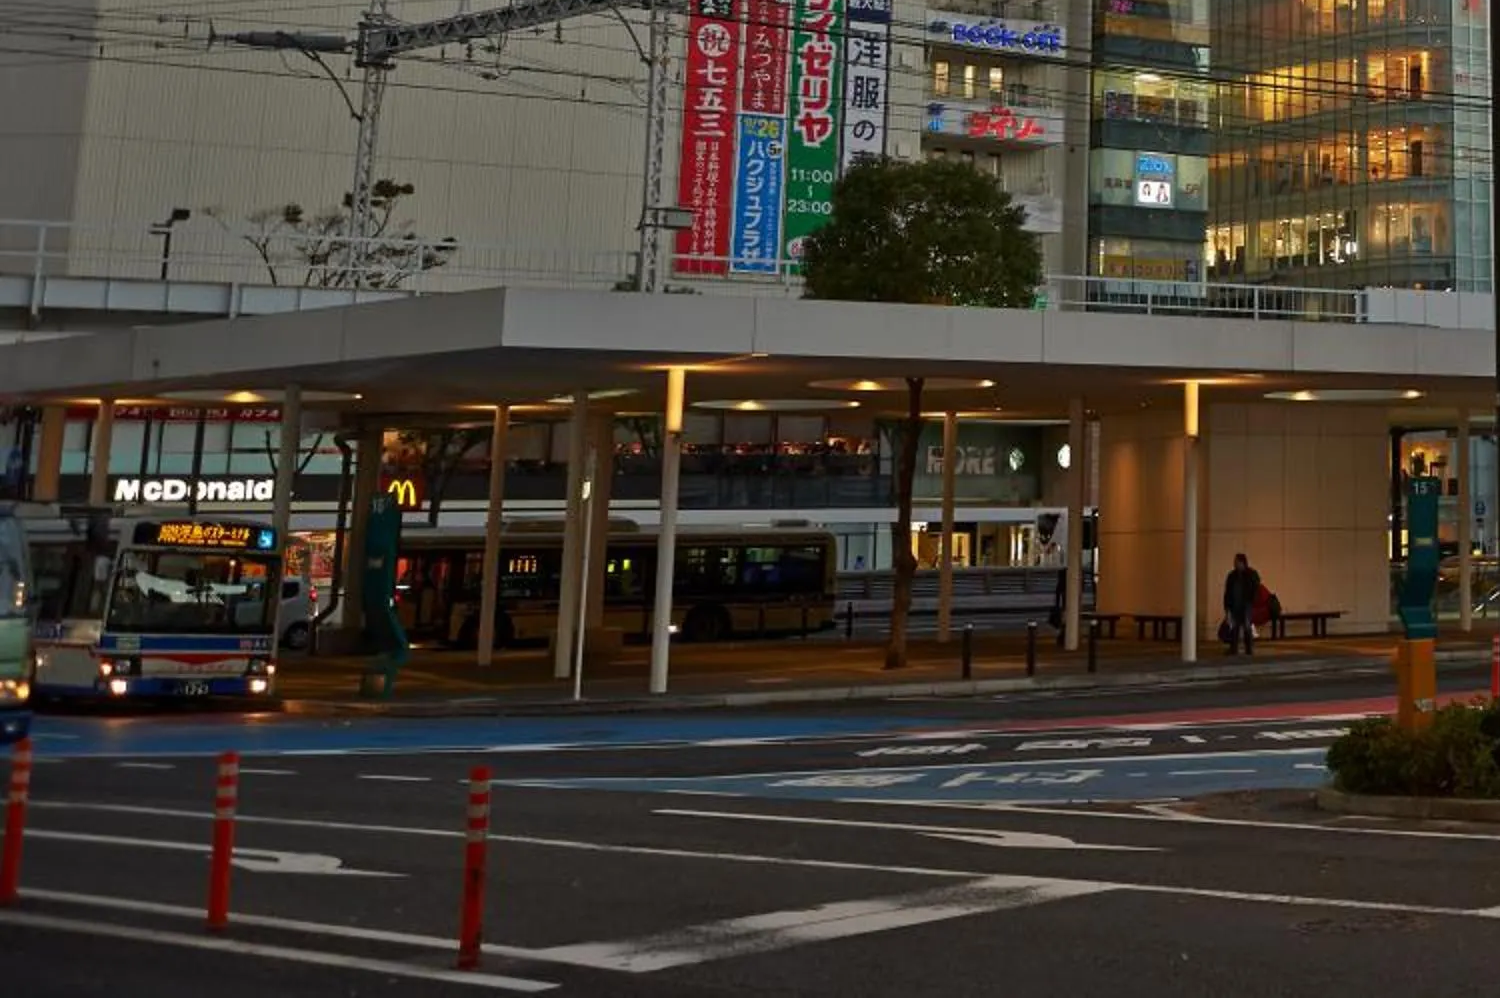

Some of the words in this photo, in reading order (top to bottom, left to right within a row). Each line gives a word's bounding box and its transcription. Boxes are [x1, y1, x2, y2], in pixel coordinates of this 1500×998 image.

[693, 60, 728, 139] 七五三
[791, 167, 833, 183] 11:00
[787, 199, 833, 215] 23:00
[113, 477, 275, 502] McDonald
